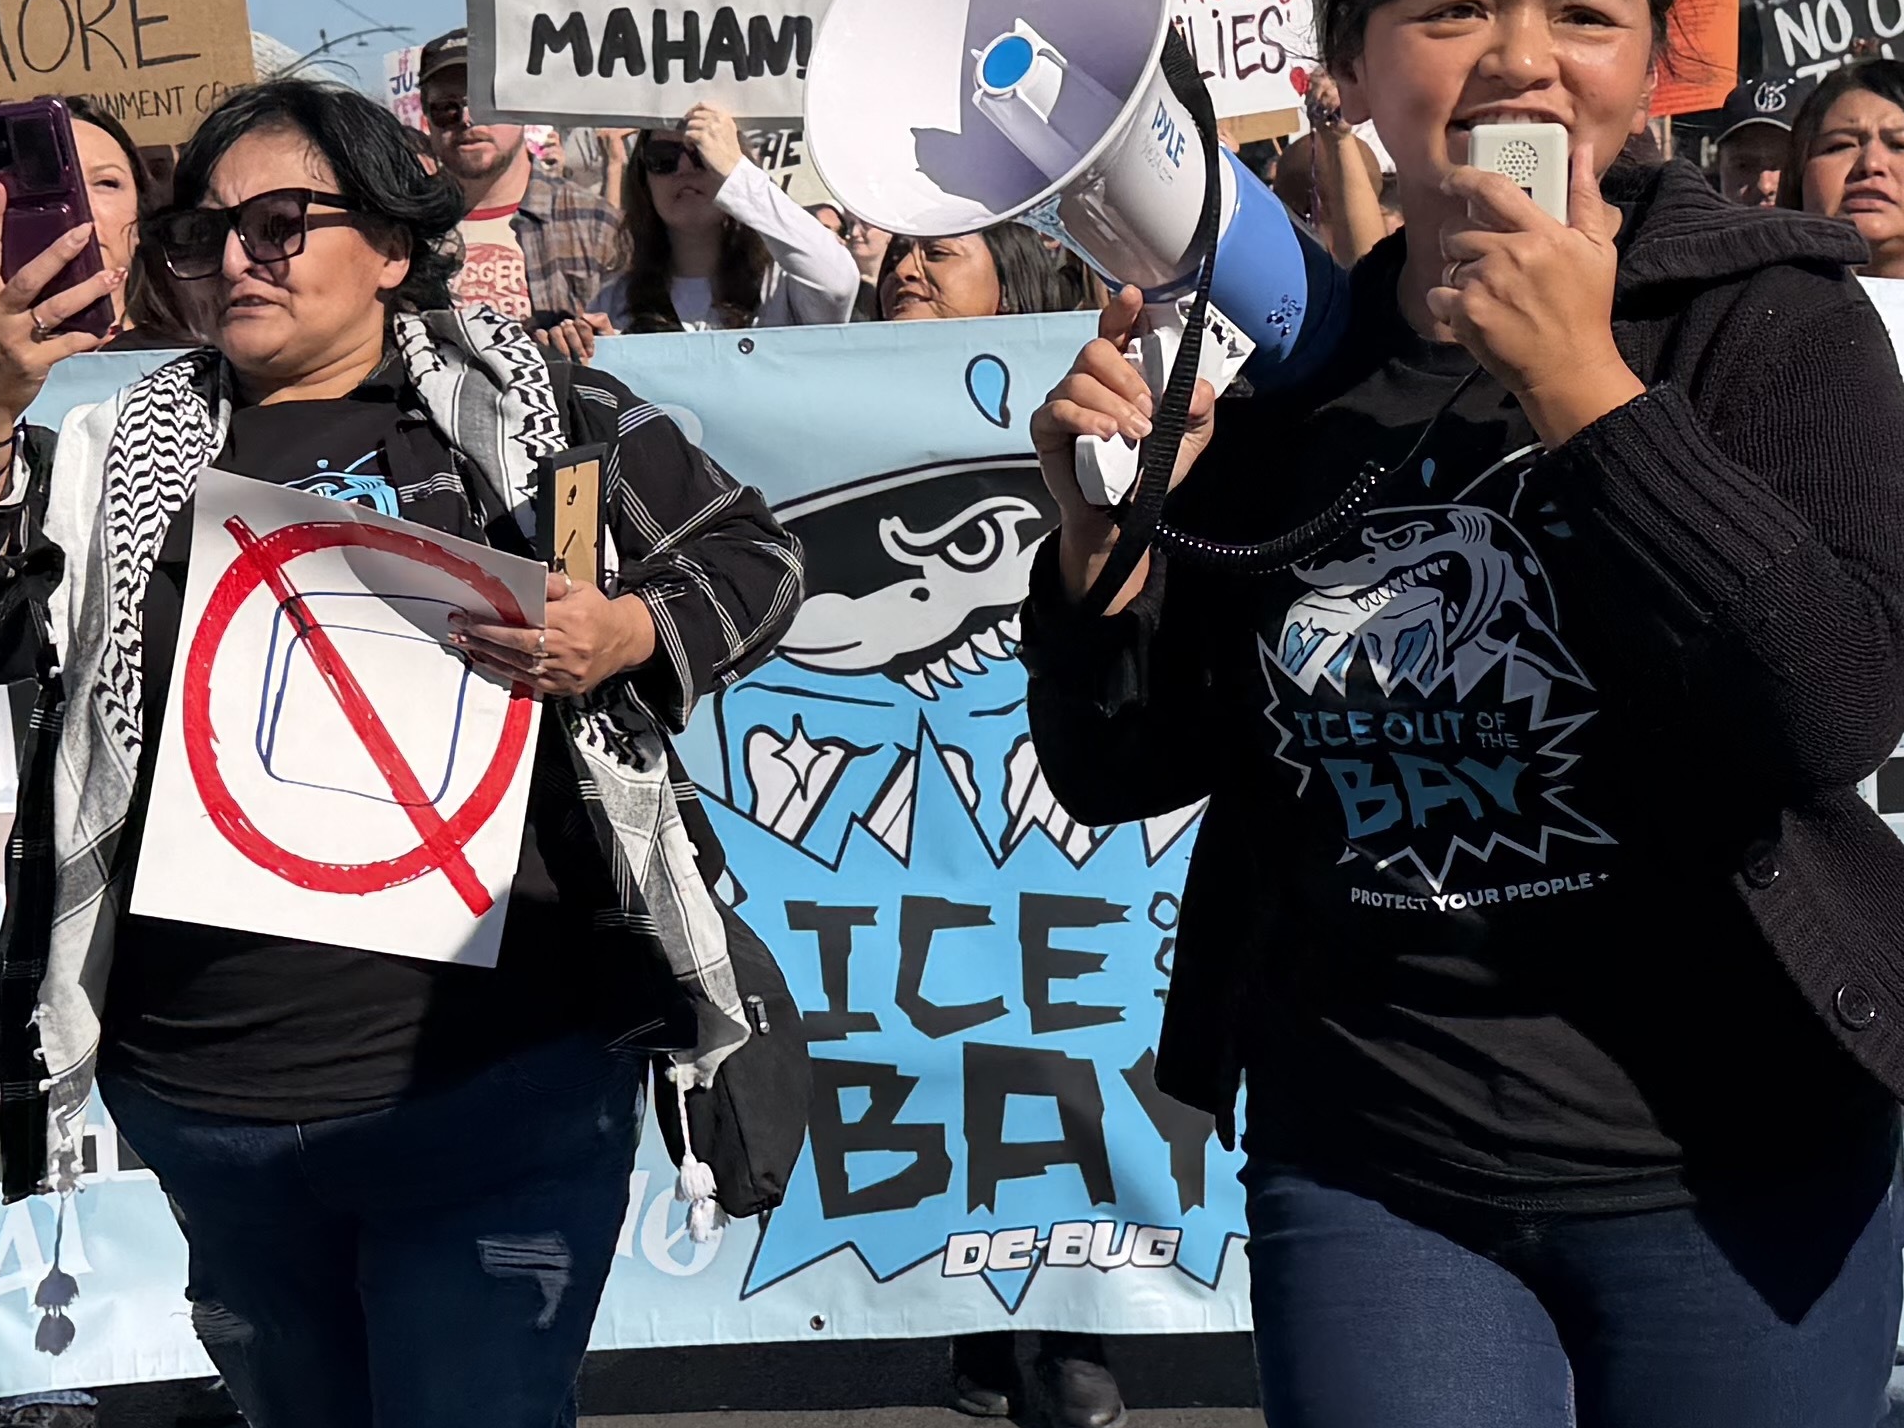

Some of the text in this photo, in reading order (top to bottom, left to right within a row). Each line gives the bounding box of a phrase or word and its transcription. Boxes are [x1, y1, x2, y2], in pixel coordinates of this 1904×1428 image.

[526, 6, 813, 85] MAHAN!
[1151, 98, 1185, 169] PYLE
[1294, 709, 1506, 747] ICE OUT OF
[1476, 732, 1520, 749] THE
[1320, 751, 1530, 839] BAY
[1351, 872, 1594, 912] PROTECT YOUR PEOPLE
[783, 892, 1132, 1041] ICE
[808, 1041, 1216, 1221] BAY
[942, 1220, 1183, 1277] DE-BUG
